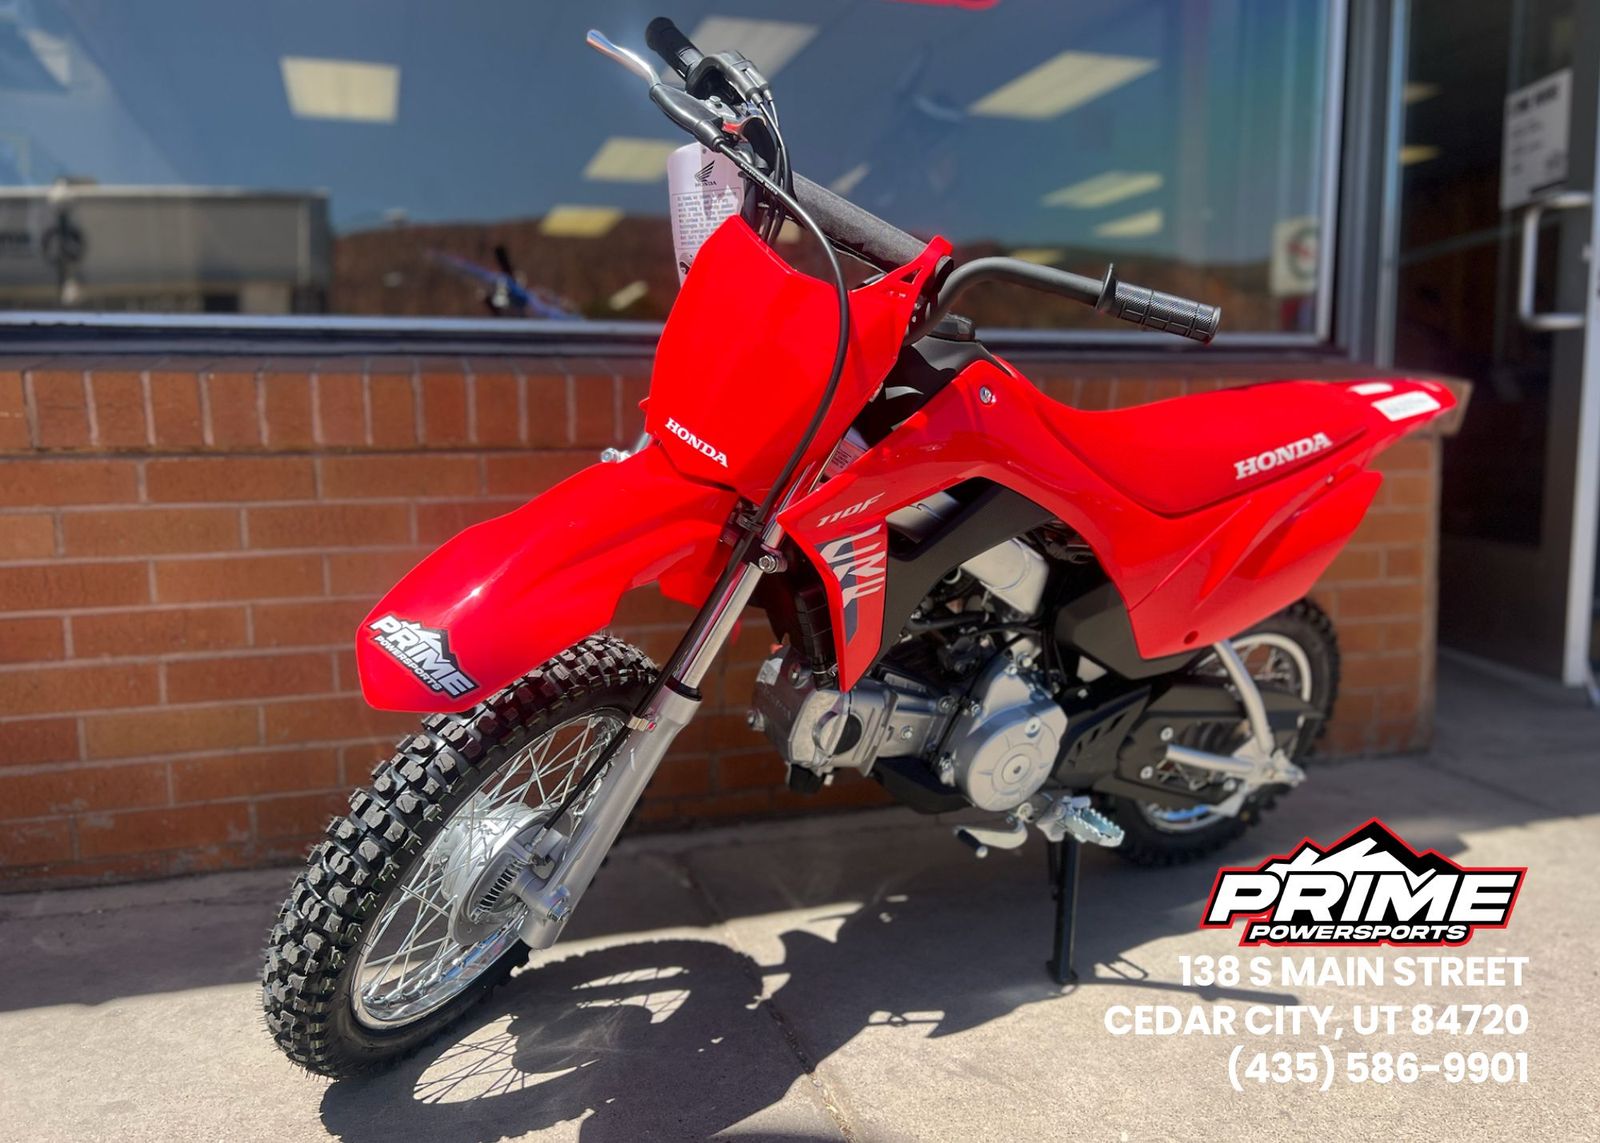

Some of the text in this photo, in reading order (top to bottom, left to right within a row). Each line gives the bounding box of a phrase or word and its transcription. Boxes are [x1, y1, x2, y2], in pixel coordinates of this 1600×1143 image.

[665, 417, 729, 468] HONDA
[1233, 432, 1333, 480] HONDA
[816, 491, 886, 528] 110F
[820, 524, 886, 609] CRF
[370, 615, 475, 696] PRIME
[374, 635, 443, 691] POWERSPORTS
